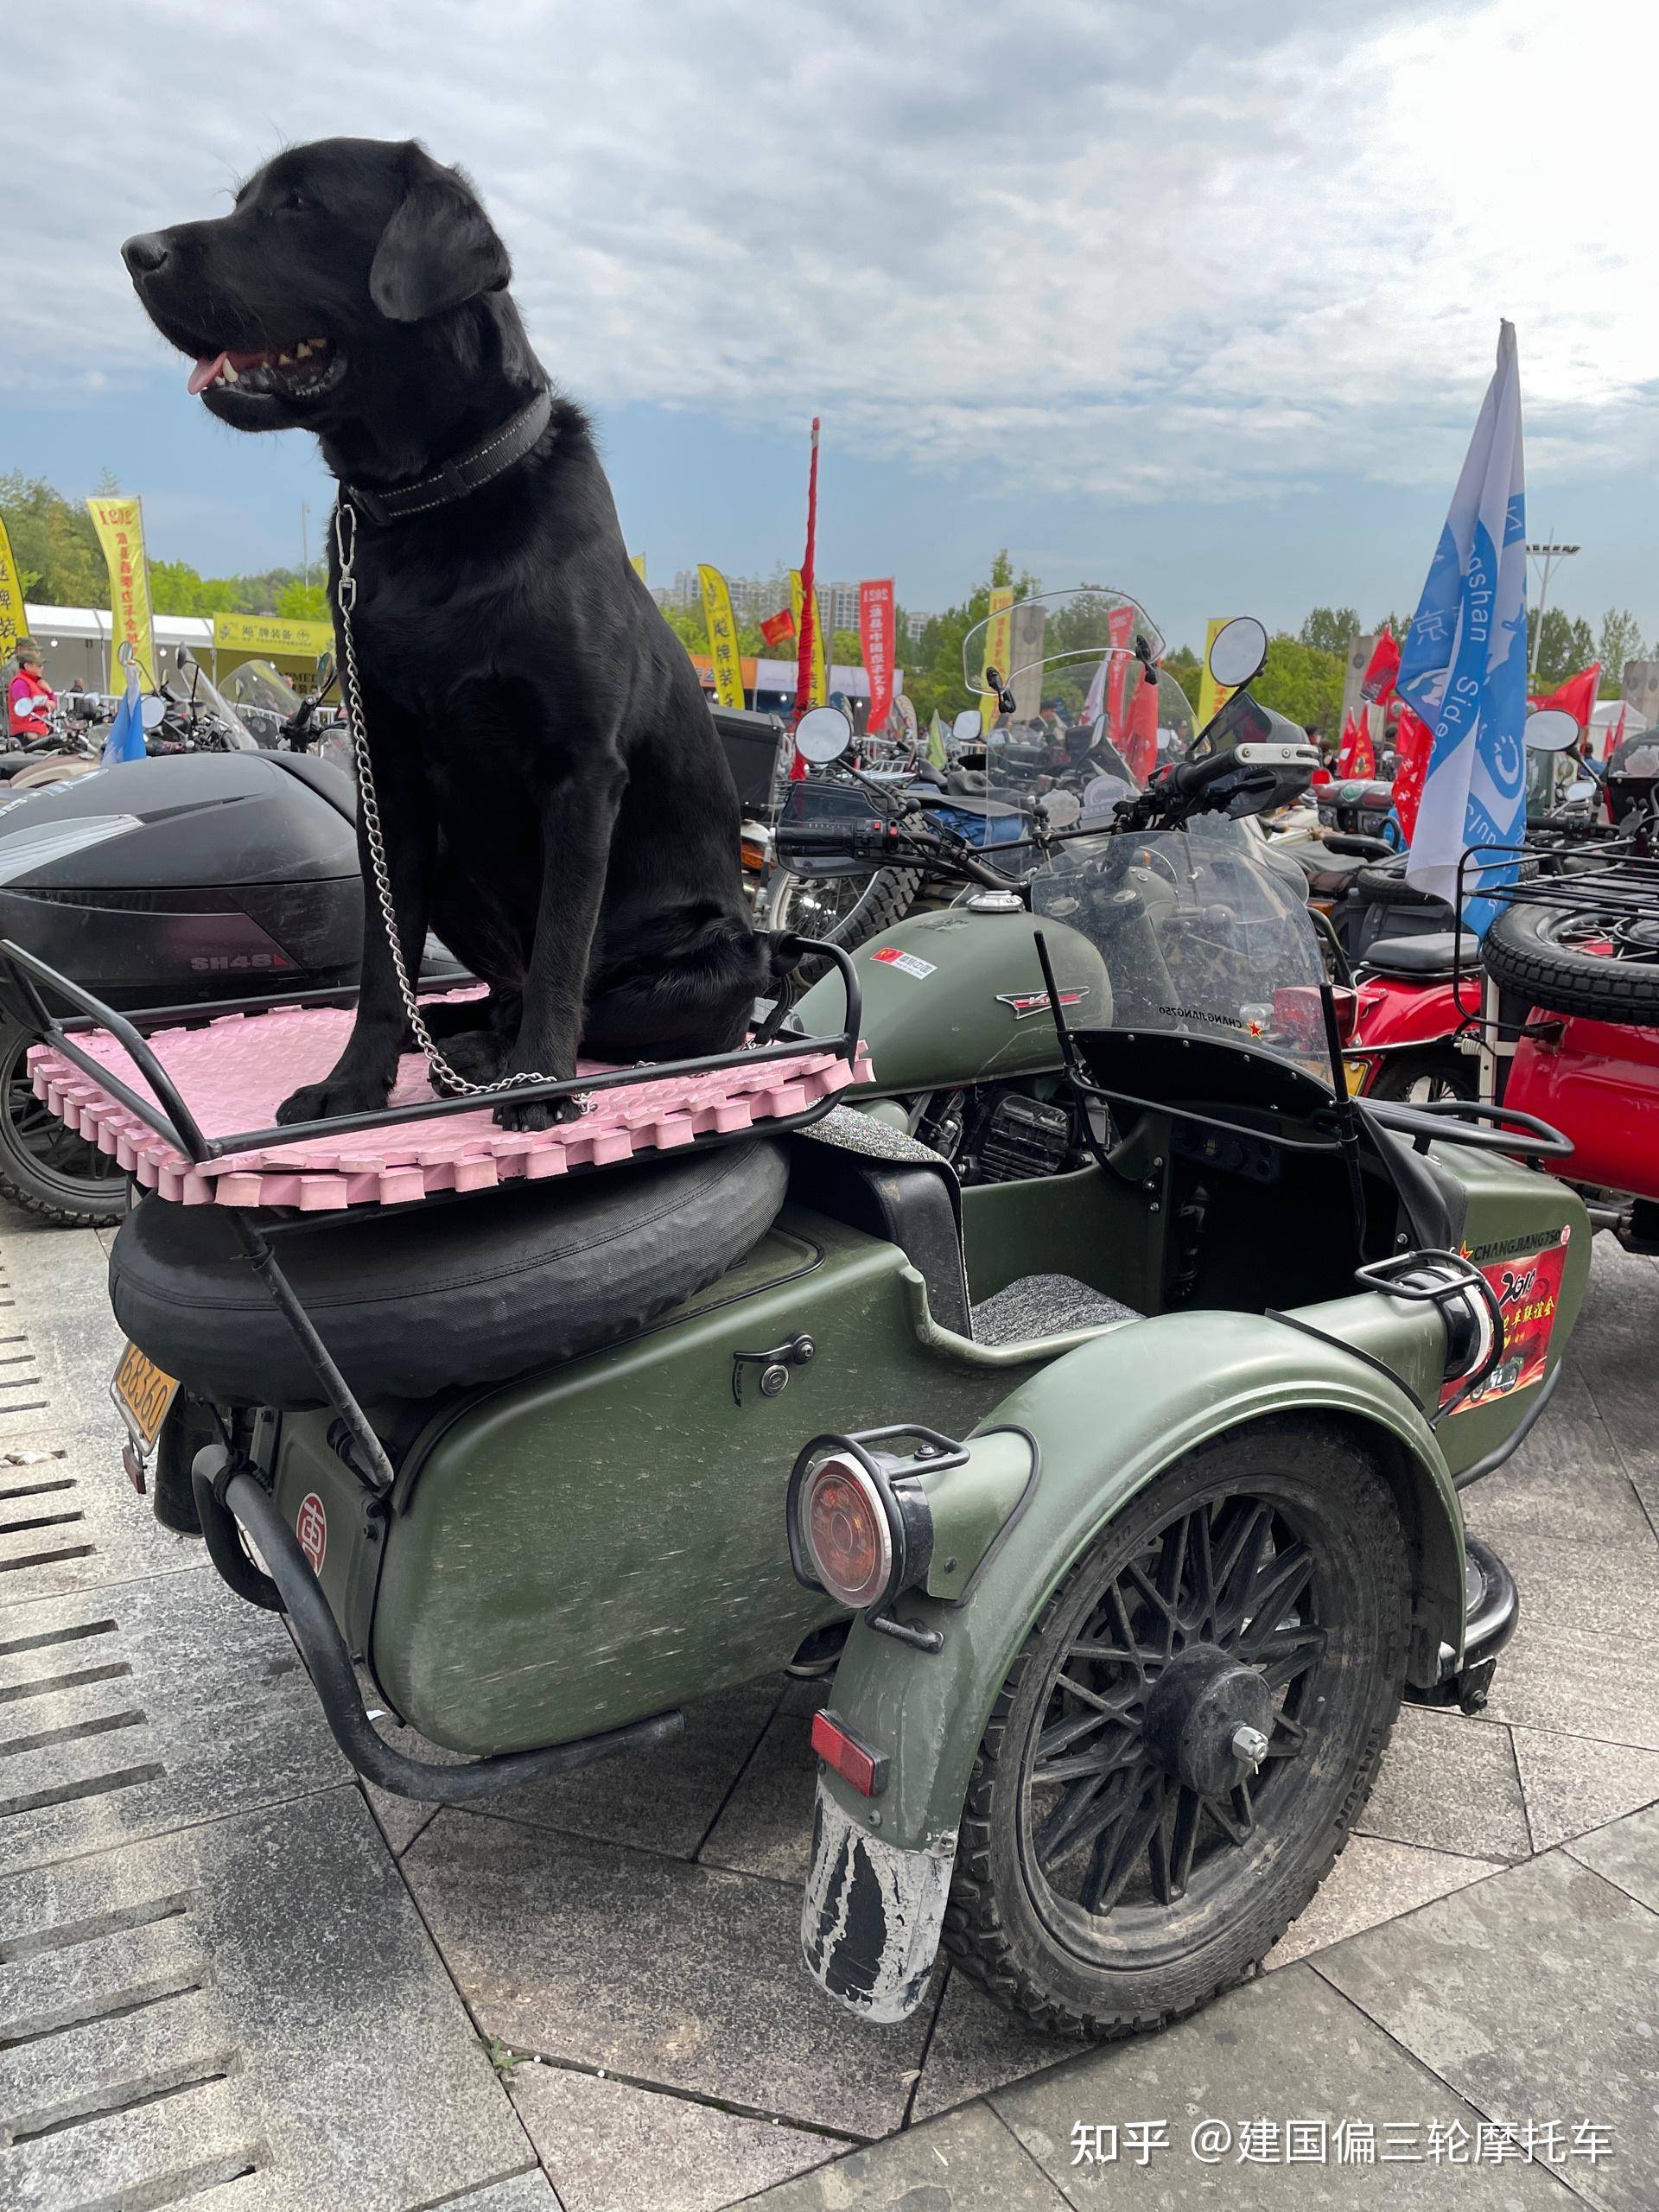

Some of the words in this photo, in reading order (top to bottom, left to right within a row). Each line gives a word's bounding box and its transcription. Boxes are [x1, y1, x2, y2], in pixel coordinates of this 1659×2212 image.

[190, 953, 272, 970] SH48
[1473, 1229, 1562, 1262] CHANGJIANG750
[121, 1348, 168, 1433] 68360
